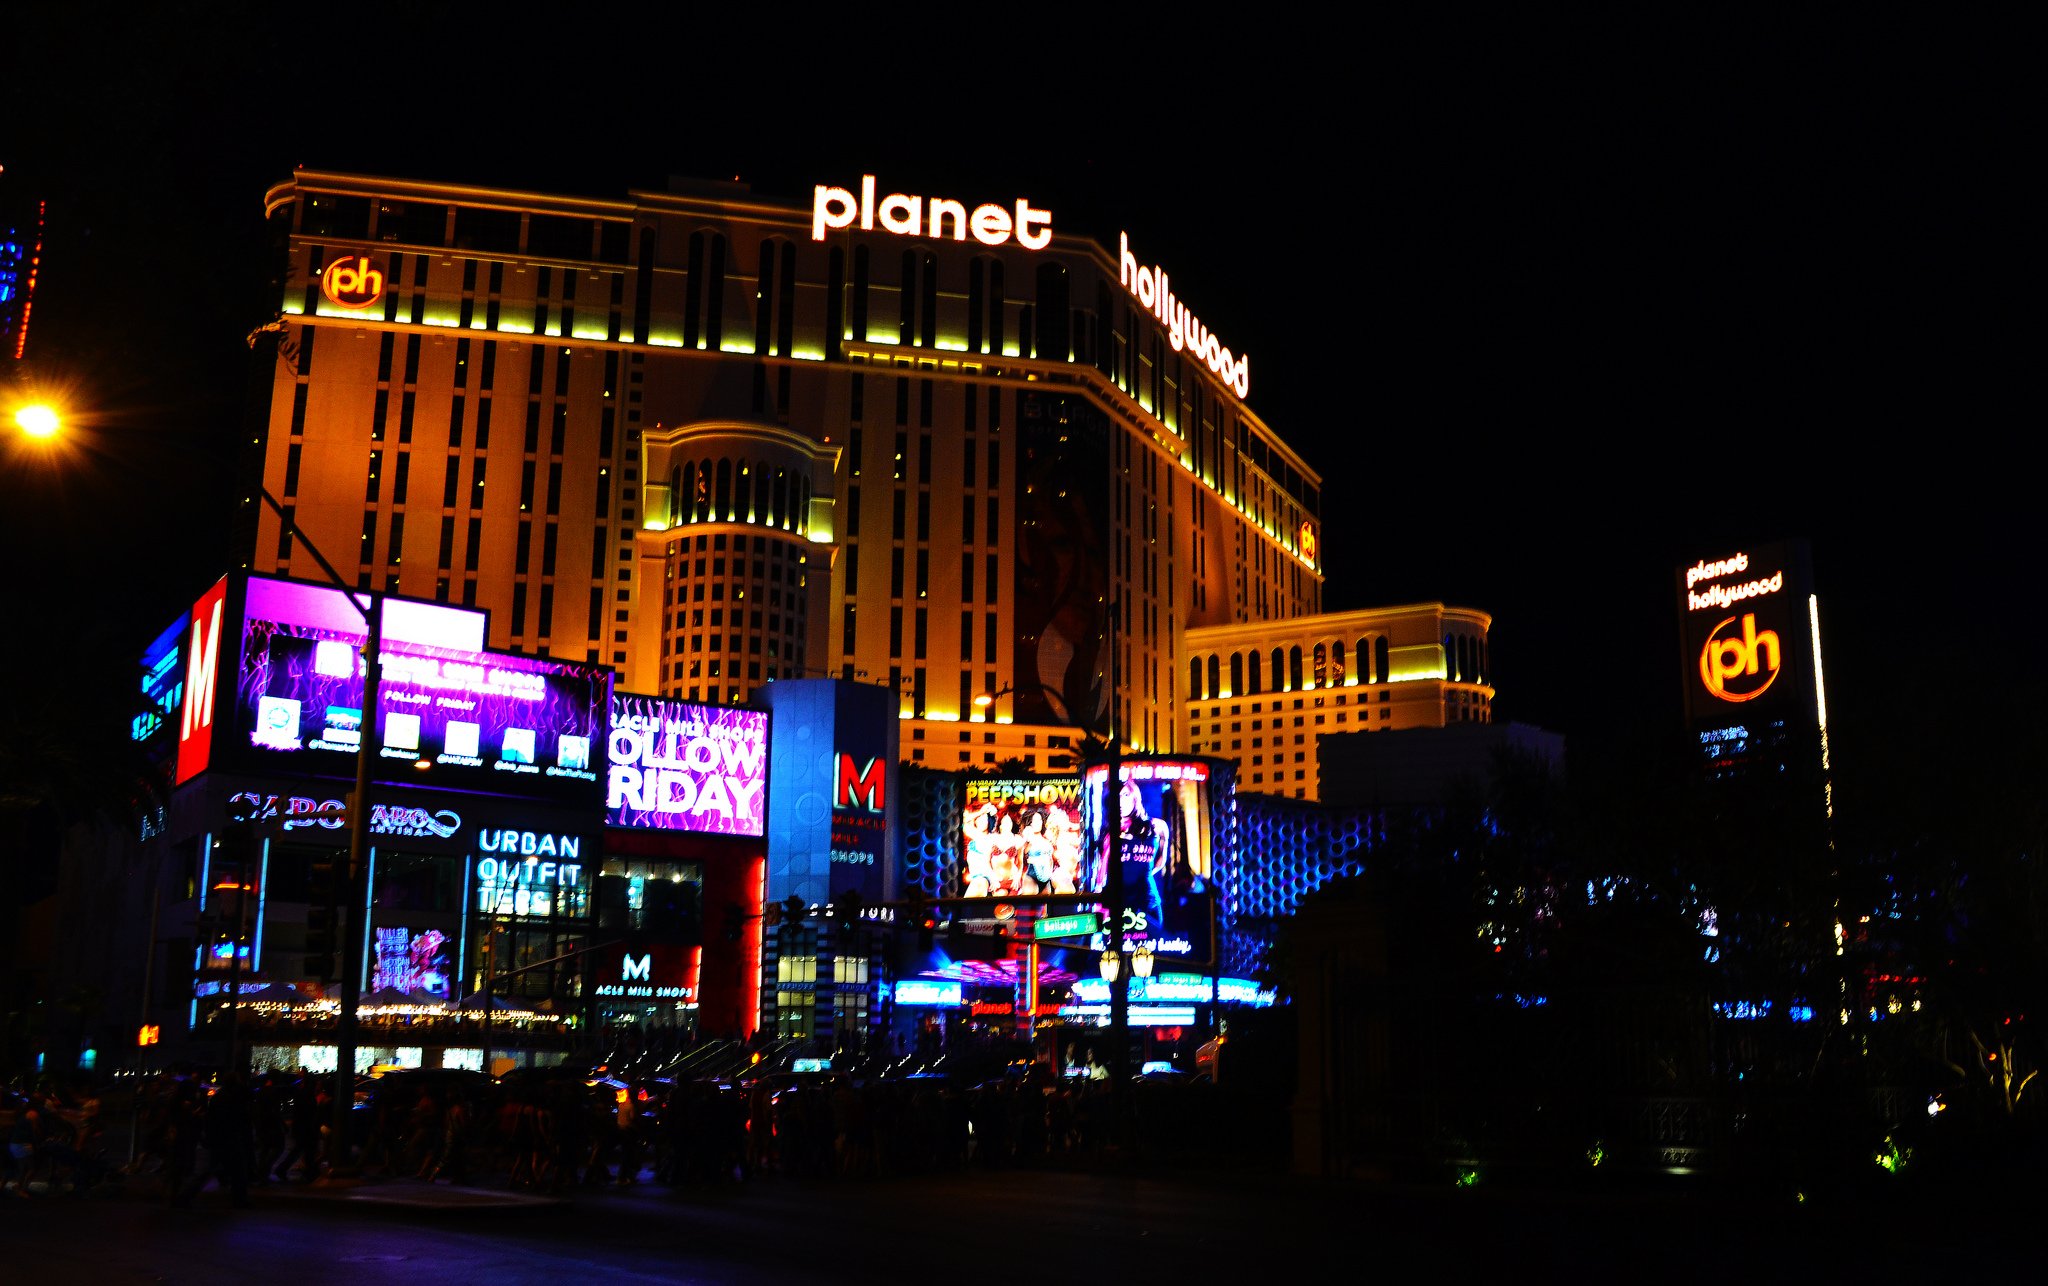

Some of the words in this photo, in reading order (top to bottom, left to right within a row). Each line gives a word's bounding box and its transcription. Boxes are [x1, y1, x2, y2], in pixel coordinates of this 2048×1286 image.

[812, 174, 1053, 250] planet
[330, 256, 383, 299] ph
[1120, 230, 1249, 399] hollywood
[1687, 552, 1748, 589] planet
[1688, 571, 1783, 612] hollywood
[181, 598, 222, 742] M
[1709, 612, 1781, 691] ph
[384, 690, 431, 706] FOLLOW
[436, 697, 476, 712] FRIDAY
[608, 728, 763, 776] OLLOW
[608, 765, 765, 820] RIDAY
[833, 752, 886, 813] M
[965, 784, 1079, 805] PEEPSHOW
[479, 828, 579, 858] URBAN
[830, 849, 874, 866] SHOPS
[476, 857, 582, 886] OUTFIT
[1043, 919, 1079, 934] Bellagio
[622, 952, 651, 982] M
[595, 984, 625, 996] ACLE
[627, 985, 653, 997] MILE
[655, 986, 693, 998] SHOPS
[971, 1001, 1013, 1017] planet
